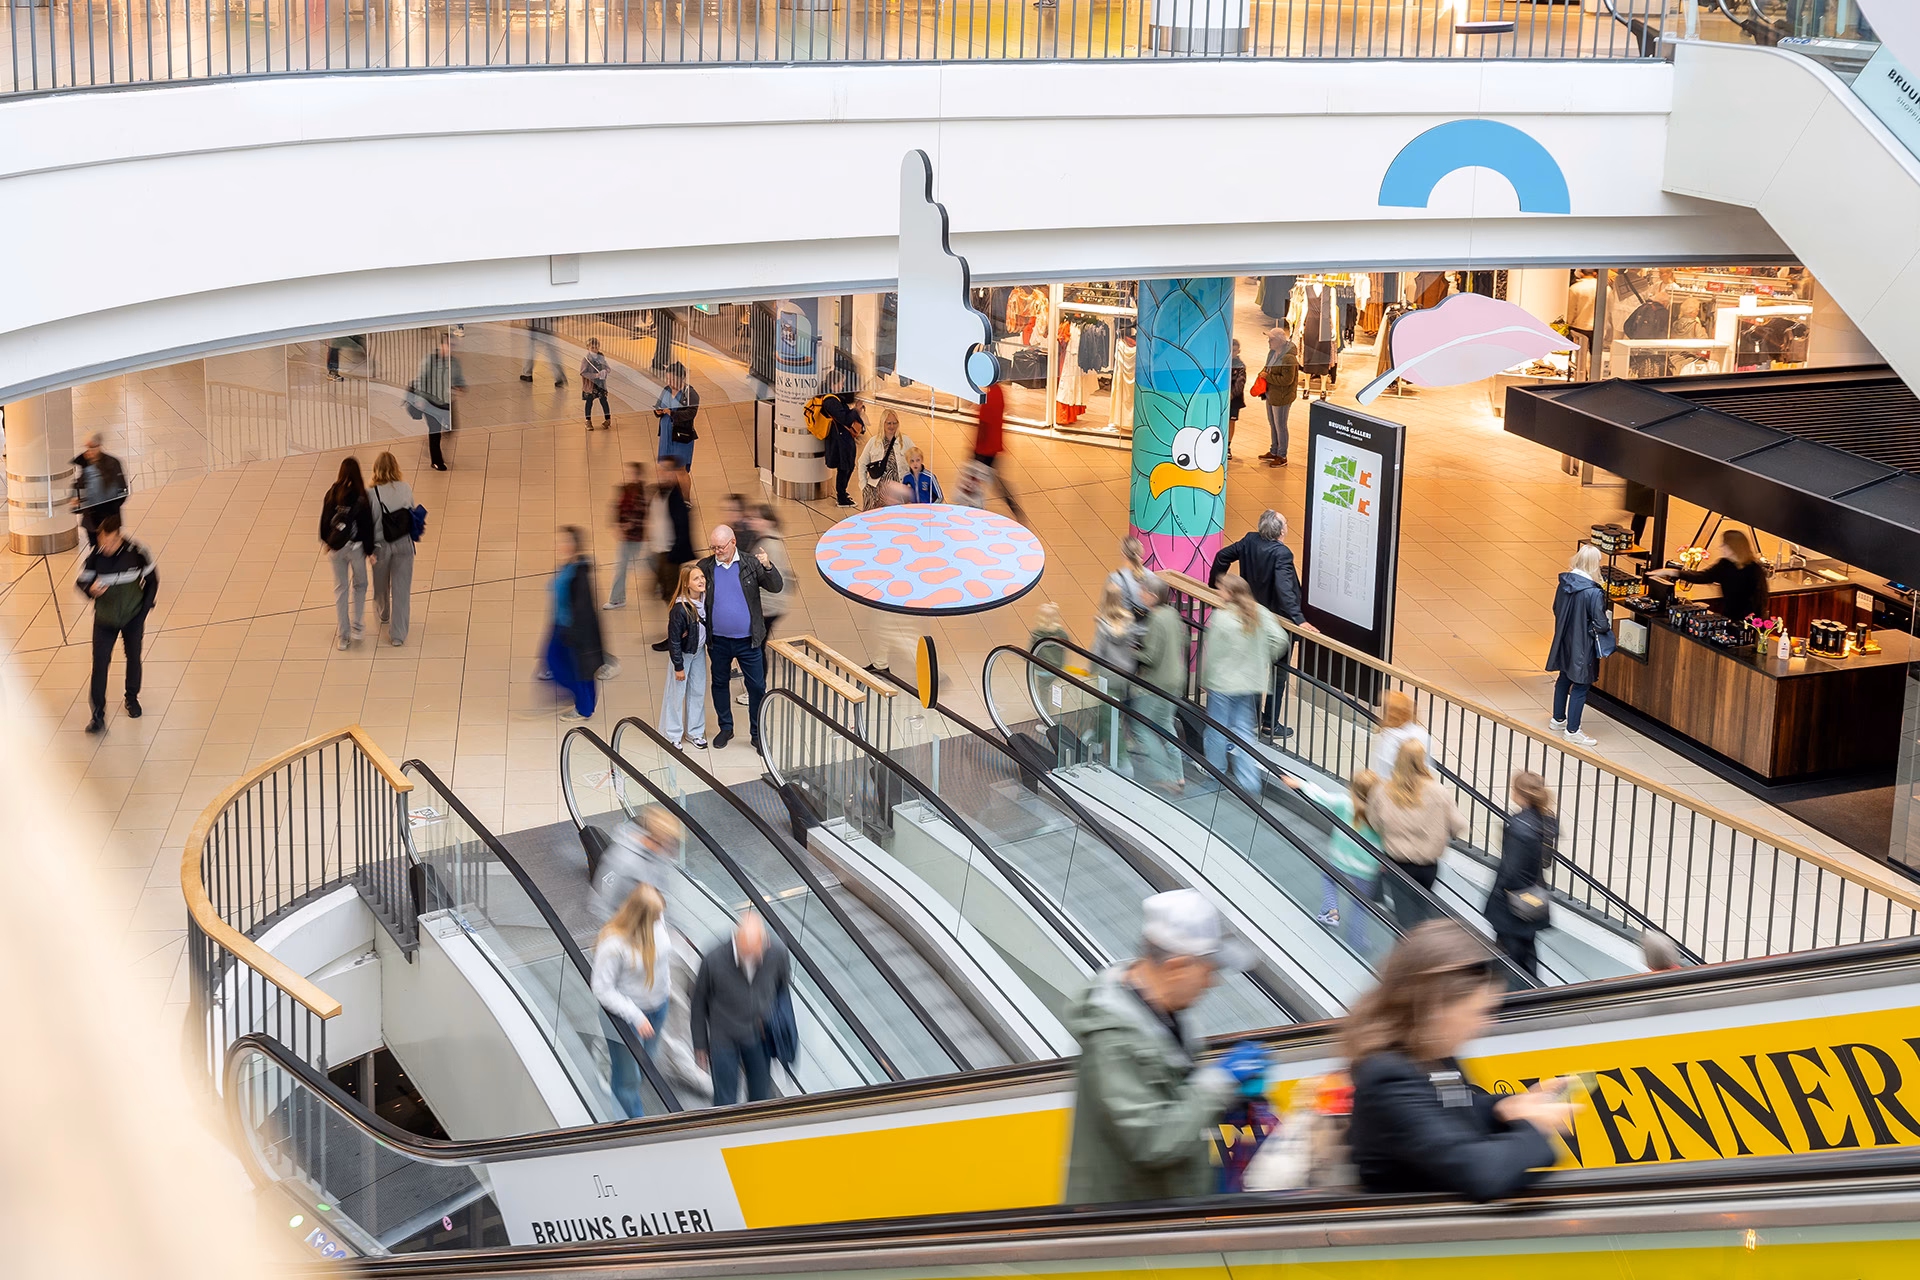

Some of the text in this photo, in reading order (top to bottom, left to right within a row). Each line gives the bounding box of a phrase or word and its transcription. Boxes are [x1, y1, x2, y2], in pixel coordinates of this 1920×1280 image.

[785, 377, 792, 388] &
[794, 377, 818, 389] VIND
[1328, 420, 1372, 439] BRUUNS GALLERI
[1518, 1037, 1920, 1168] VENNER
[531, 1208, 714, 1244] BRUUNS GALLERI
